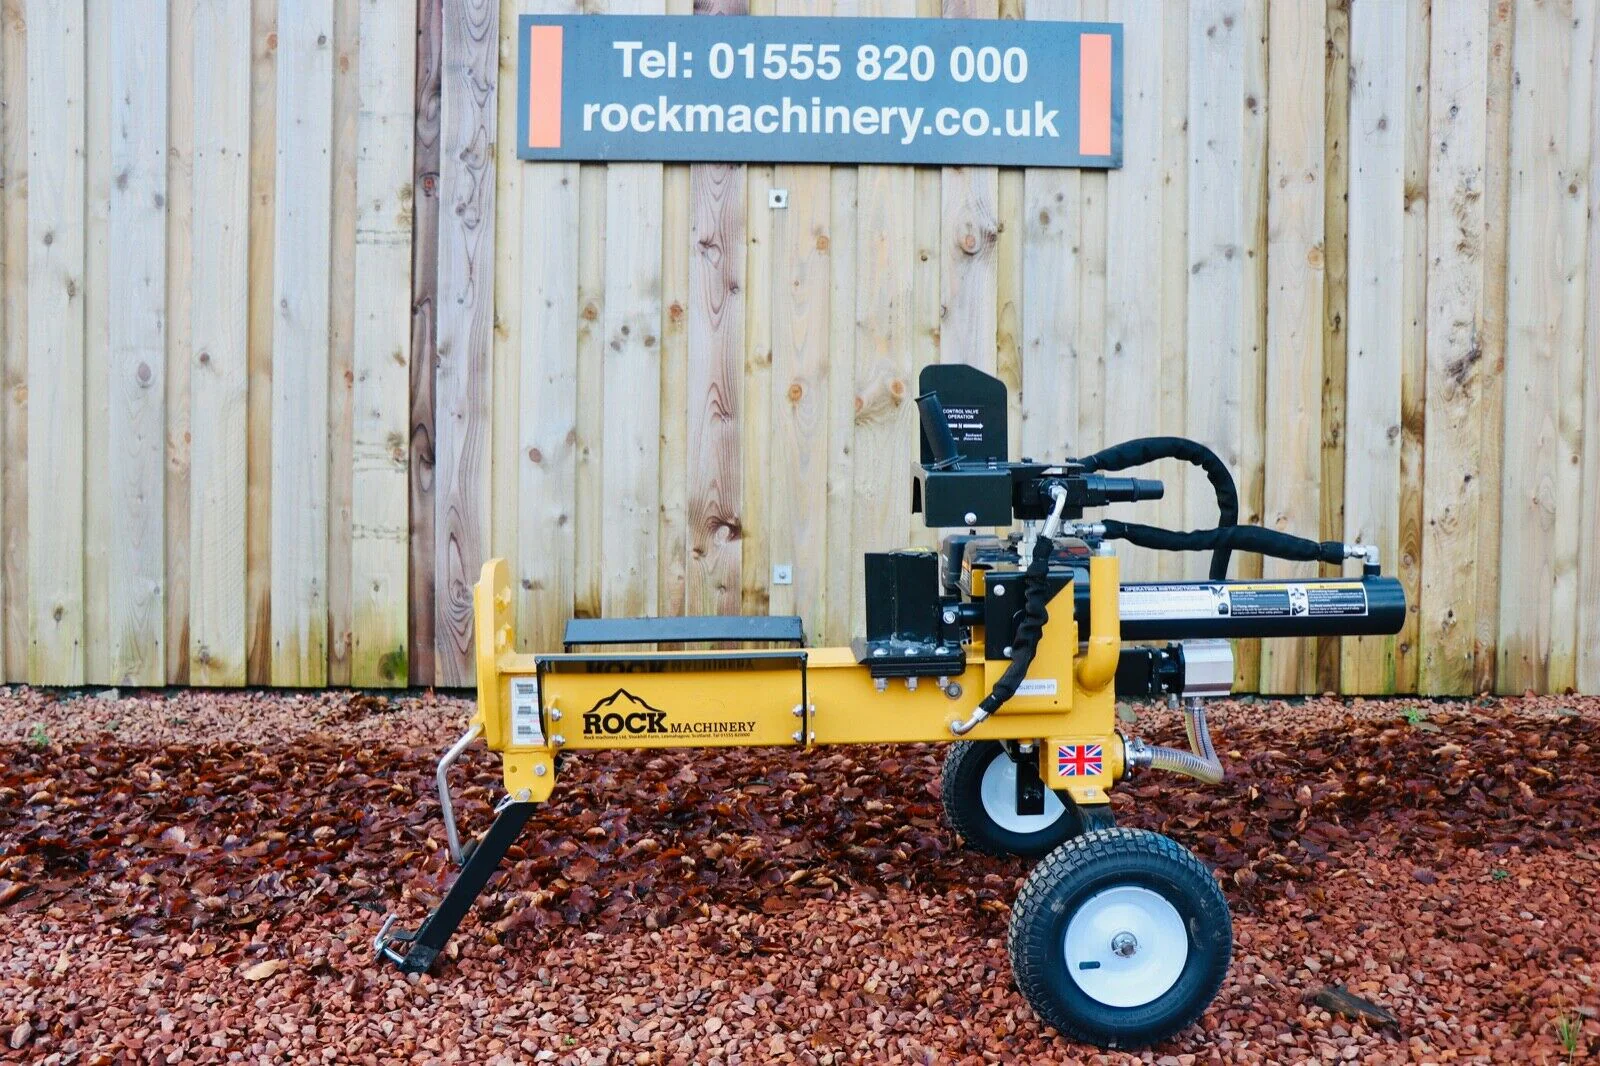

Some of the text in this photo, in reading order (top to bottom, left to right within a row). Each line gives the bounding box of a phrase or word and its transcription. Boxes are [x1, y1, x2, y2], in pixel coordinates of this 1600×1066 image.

[613, 41, 1029, 84] Tel: 01555 820 000
[582, 96, 1060, 145] rockmachinery.co.uk
[583, 713, 756, 734] ROCK MACHINERY
